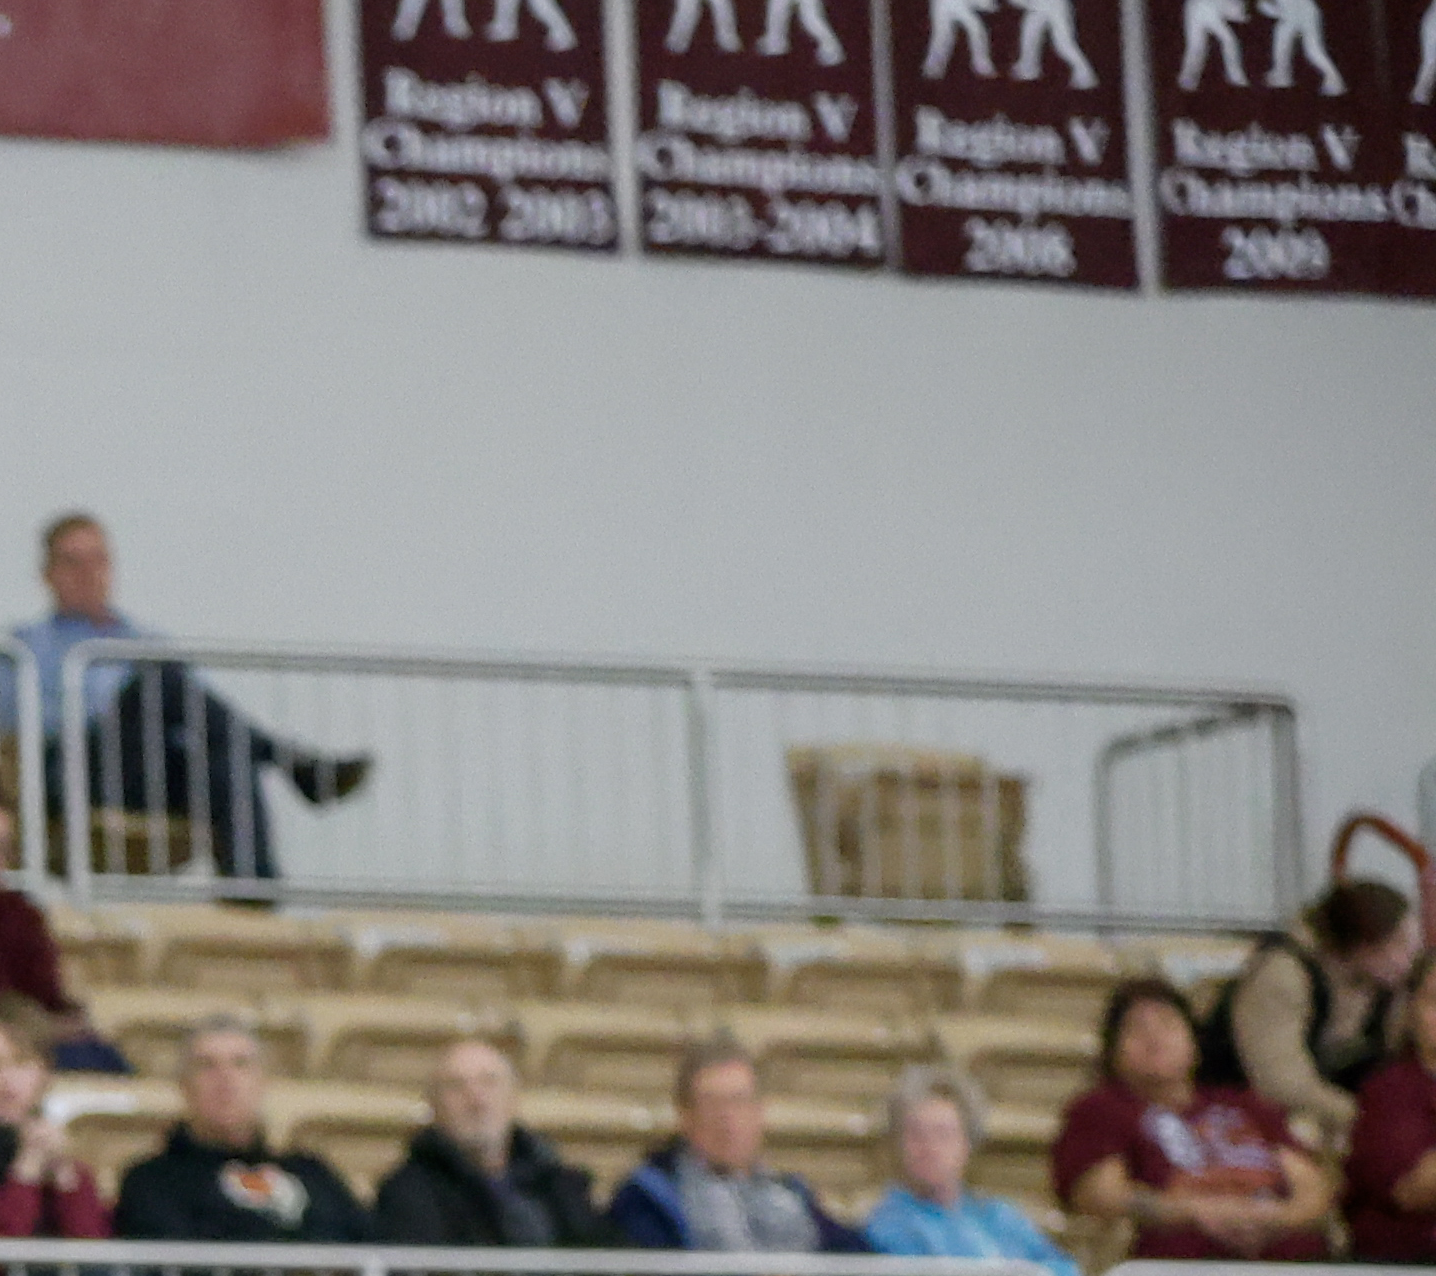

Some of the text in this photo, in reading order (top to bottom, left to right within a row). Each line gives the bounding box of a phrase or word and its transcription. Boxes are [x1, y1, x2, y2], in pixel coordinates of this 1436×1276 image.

[384, 66, 589, 131] Region V
[657, 78, 860, 144] Region V
[362, 117, 612, 182] Champions
[637, 129, 887, 196] Champions
[914, 104, 1111, 167] Region V
[1172, 116, 1321, 177] Region
[1319, 122, 1362, 172] V
[894, 153, 1133, 221] Champions
[1158, 166, 1392, 228] Champions
